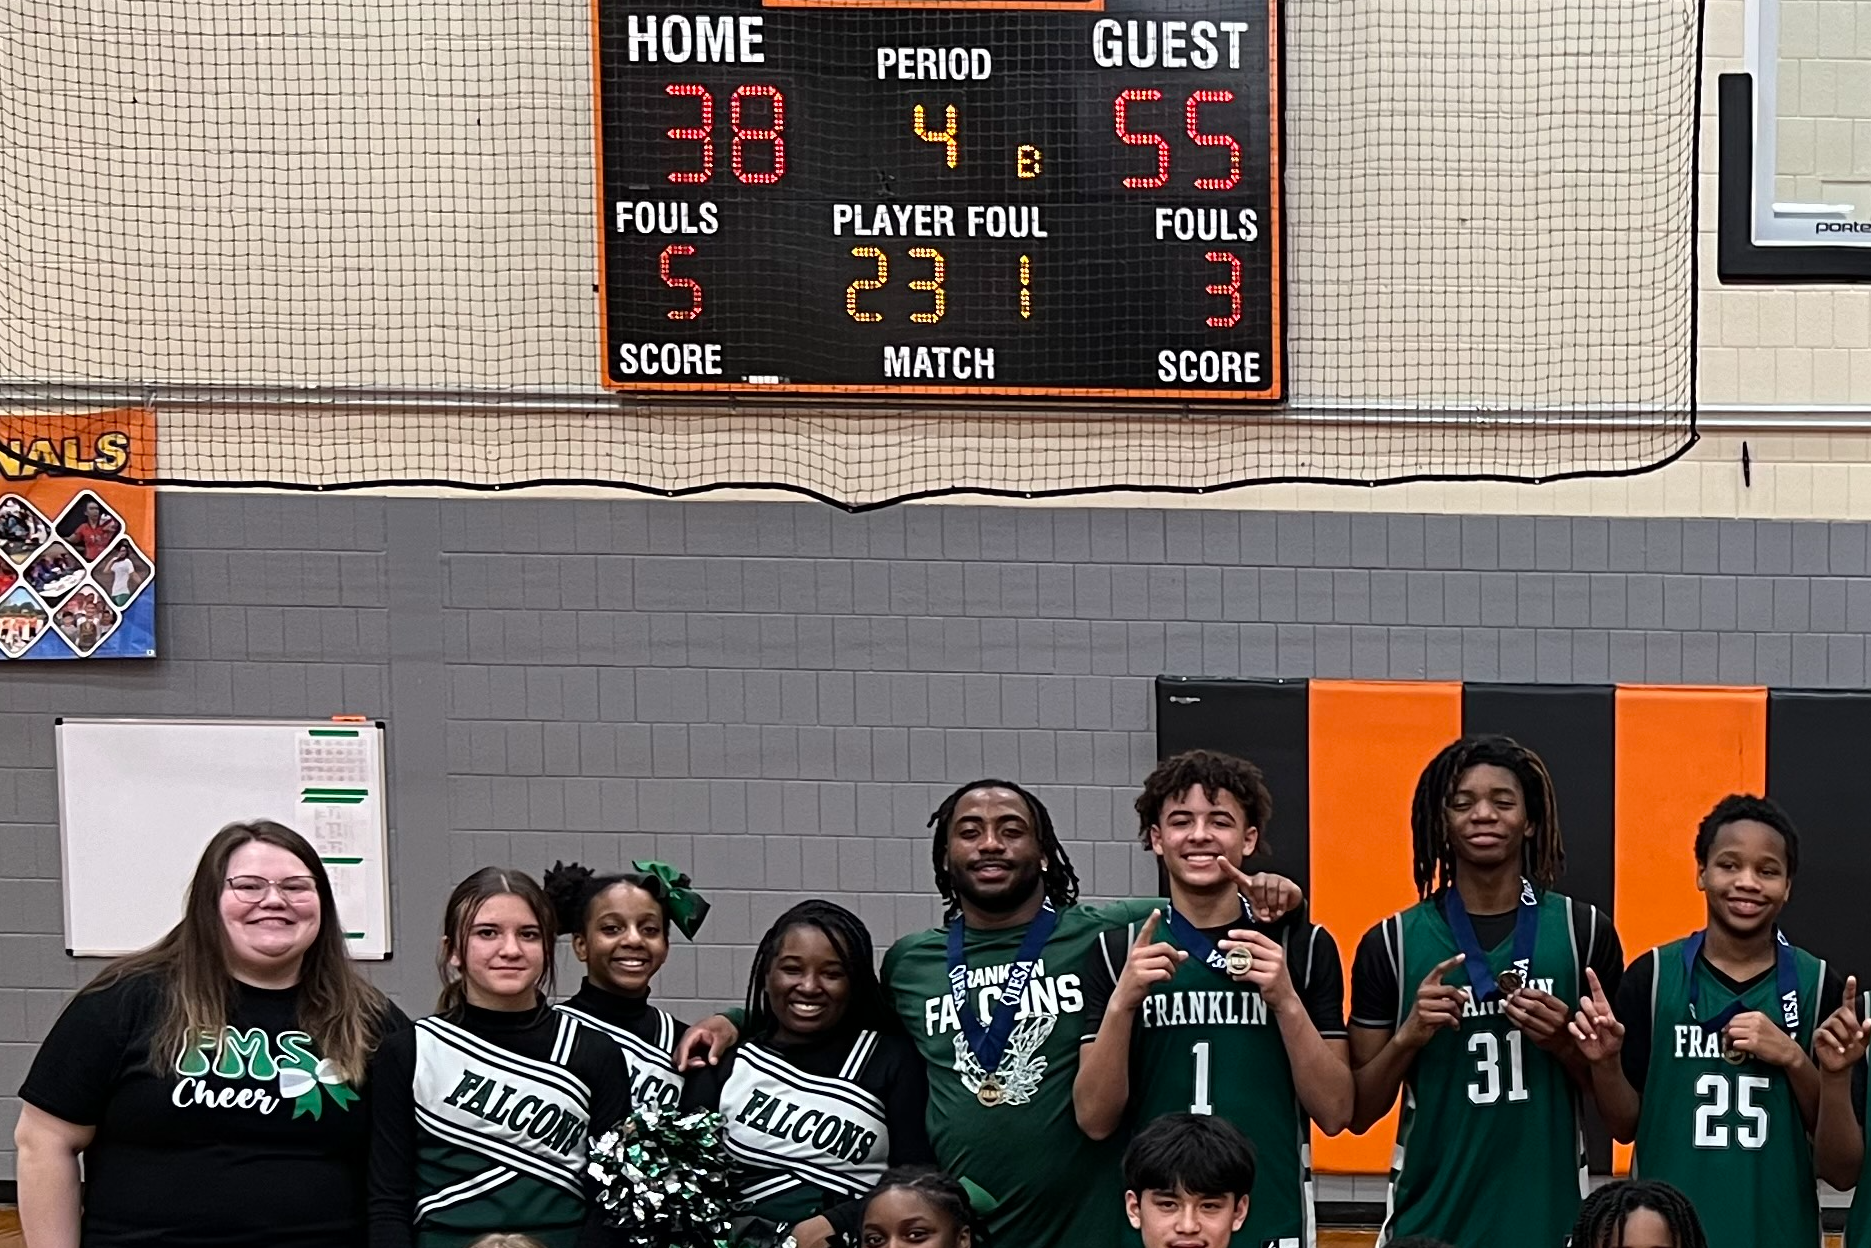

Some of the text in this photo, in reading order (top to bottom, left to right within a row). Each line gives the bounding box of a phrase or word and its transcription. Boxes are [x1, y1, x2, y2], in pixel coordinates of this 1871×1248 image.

[628, 15, 765, 64] HOME
[877, 47, 991, 81] PERIOD
[1093, 20, 1248, 69] GUEST
[666, 84, 786, 184] 38
[913, 104, 958, 169] 4
[1115, 89, 1241, 190] 55
[616, 201, 719, 235] FOULS
[833, 205, 1048, 239] PLAYER FOUL
[1155, 207, 1258, 242] FOULS
[659, 243, 703, 320] 5
[846, 246, 946, 324] 23
[1019, 254, 1031, 320] 1
[1205, 250, 1242, 329] 3
[619, 343, 723, 376] SCORE
[883, 346, 996, 381] MATCH
[1157, 349, 1261, 383] SCORE
[925, 973, 1084, 1037] FACNS
[1008, 961, 1033, 1000] IESA
[1782, 990, 1799, 1028] IESA
[1142, 991, 1267, 1028] FRANKLIN
[176, 1025, 322, 1082] FMS
[1190, 1042, 1213, 1116] 1
[1467, 1030, 1529, 1105] 31
[172, 1076, 280, 1115] Cheer
[443, 1069, 588, 1157] FALCONS
[1694, 1074, 1770, 1148] 25
[735, 1088, 878, 1166] FALCONS
